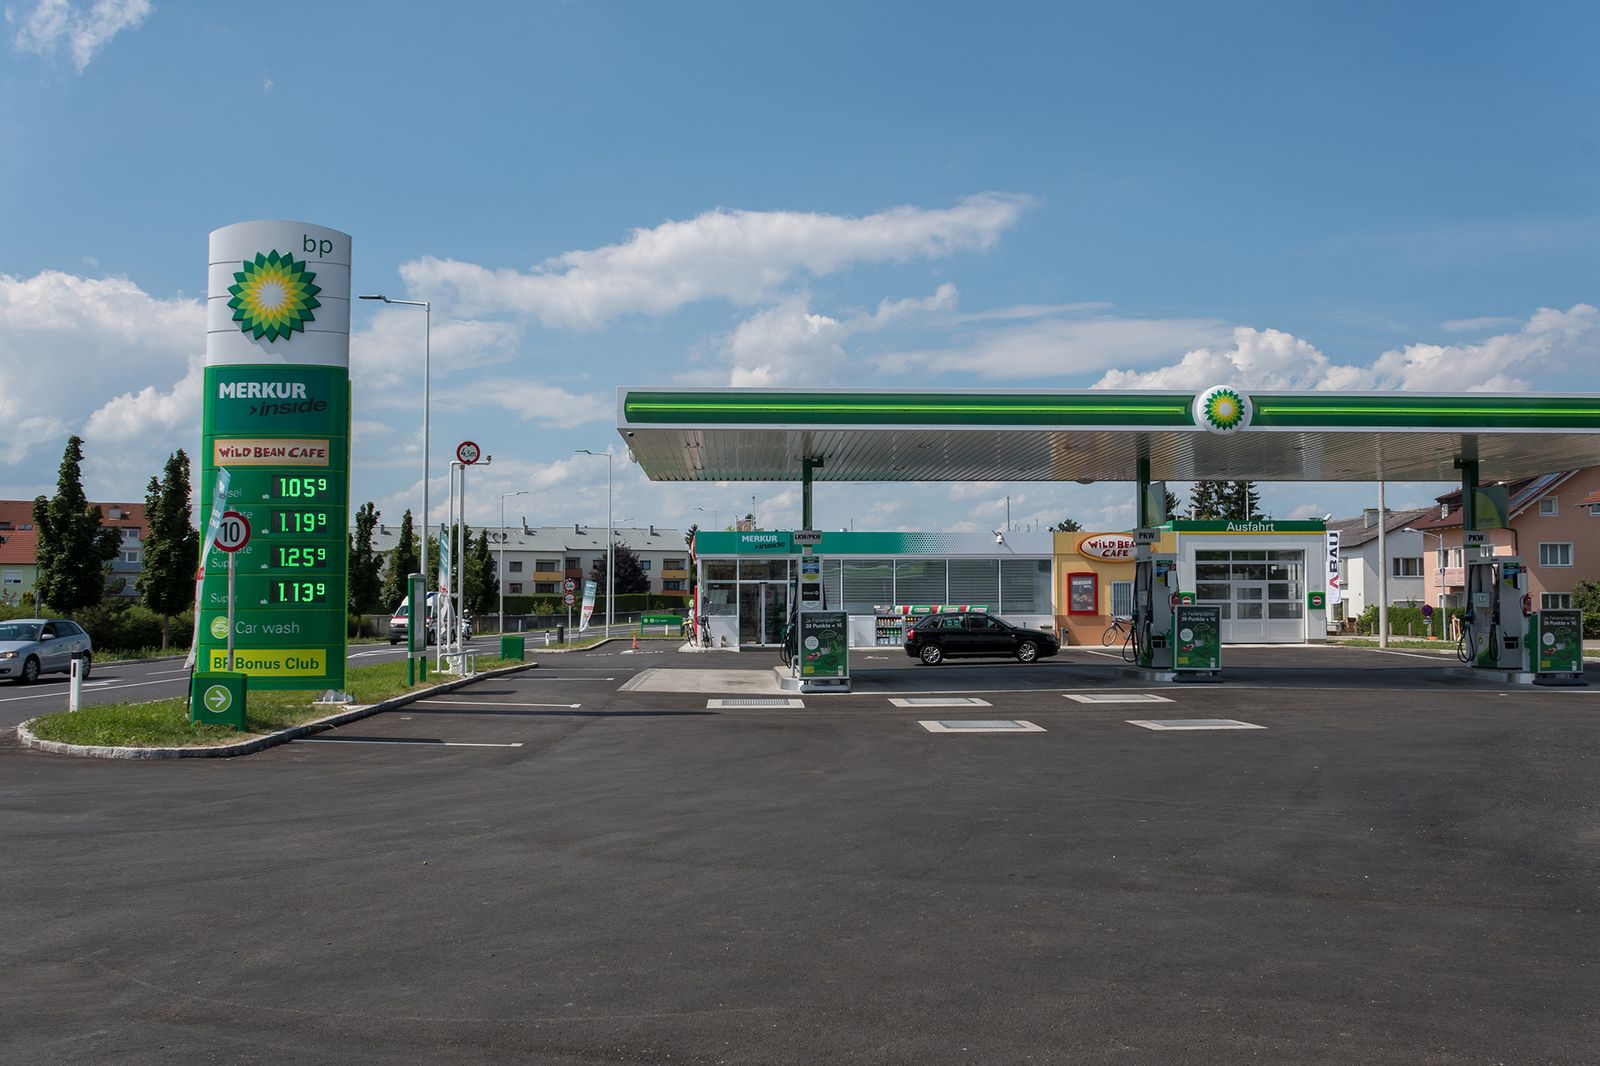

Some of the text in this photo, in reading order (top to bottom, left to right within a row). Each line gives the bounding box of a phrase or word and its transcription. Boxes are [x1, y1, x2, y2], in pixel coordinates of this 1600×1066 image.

[303, 234, 333, 258] bp
[219, 382, 307, 399] MERKUR
[254, 447, 285, 458] BEAN
[288, 447, 325, 458] CAFE
[220, 521, 240, 543] 10
[1226, 521, 1274, 532] Ausfahrt
[742, 535, 778, 543] MERKUR
[1117, 540, 1137, 549] BEA
[1102, 549, 1129, 557] CAFE
[212, 558, 239, 570] Supr
[211, 592, 239, 604] Supr
[235, 621, 300, 634] Car wash
[236, 657, 280, 669] Bonus
[285, 657, 319, 669] Club
